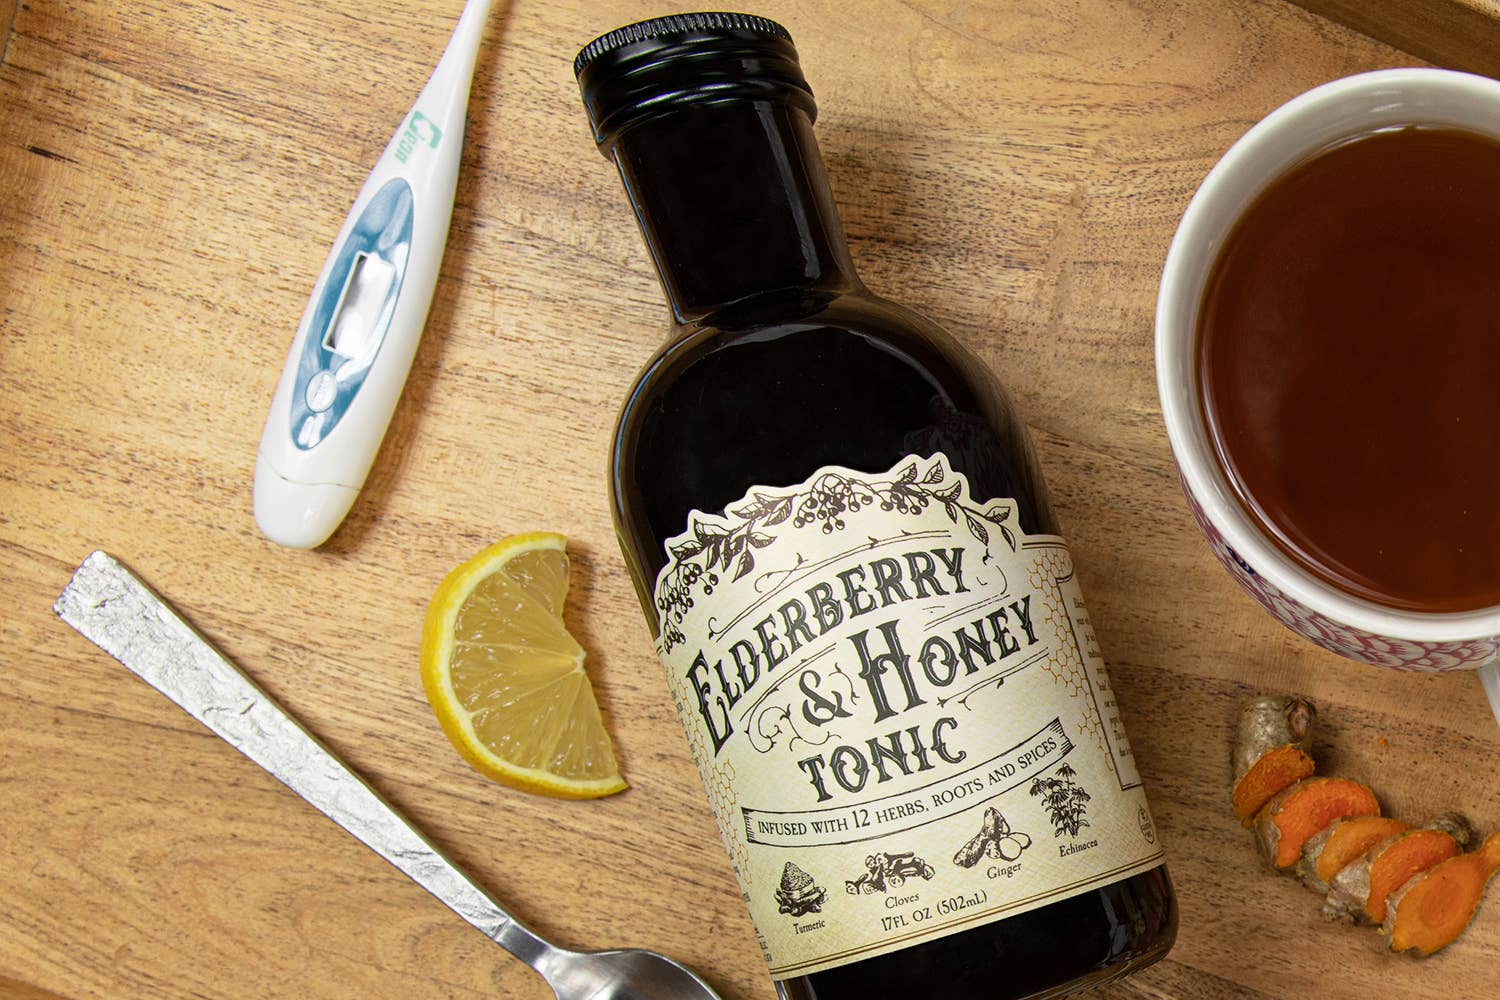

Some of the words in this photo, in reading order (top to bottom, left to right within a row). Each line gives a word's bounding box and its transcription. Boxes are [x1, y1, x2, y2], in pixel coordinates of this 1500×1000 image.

[685, 547, 971, 758] ELDERBERRY
[799, 670, 853, 727] &
[847, 594, 1039, 724] HONEY
[797, 717, 967, 802] TONIC
[757, 820, 808, 836] INFUSED
[811, 817, 849, 834] WITH
[852, 808, 872, 829] 12
[931, 778, 984, 807] ROOTS
[988, 763, 1016, 786] AND
[1017, 737, 1057, 769] SPICES
[1058, 839, 1099, 858] Echinacea
[986, 862, 1022, 880] Ginger
[880, 911, 909, 932] 17FL
[912, 907, 933, 923] OZ
[936, 889, 988, 917] (502mL)
[884, 891, 920, 909] Cloves
[793, 919, 826, 935] Turmeric
